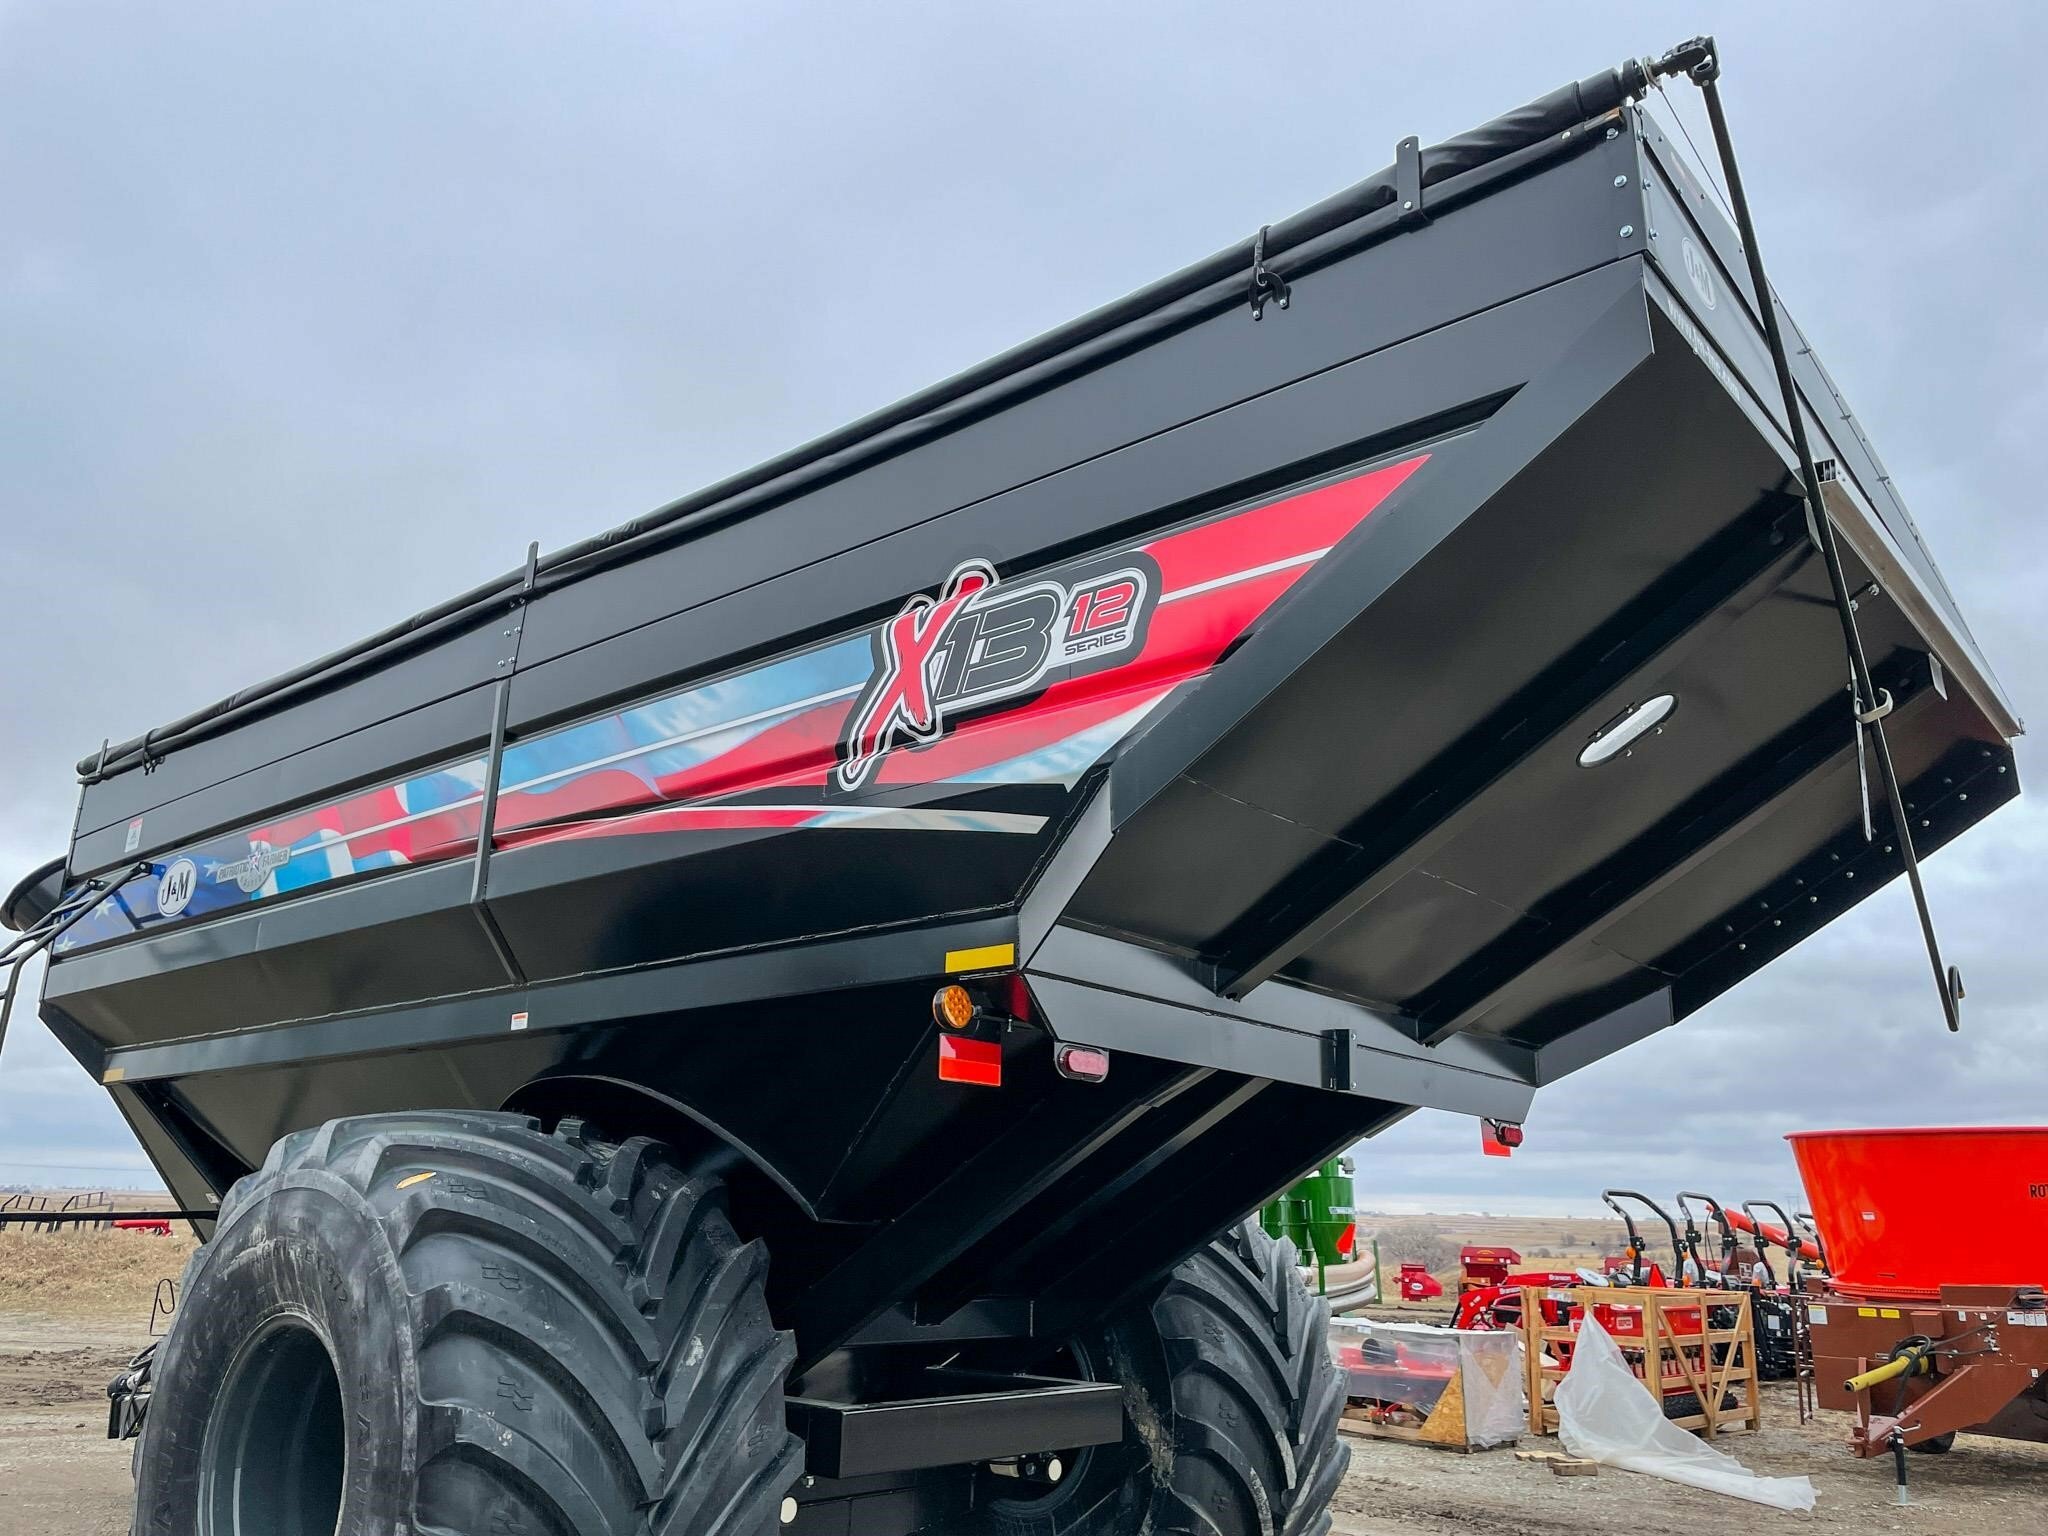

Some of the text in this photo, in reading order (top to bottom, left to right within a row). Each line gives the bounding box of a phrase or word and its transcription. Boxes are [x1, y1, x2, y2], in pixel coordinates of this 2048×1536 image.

[1069, 582, 1135, 636] 12
[1064, 629, 1128, 657] SERIES
[161, 867, 192, 906] J&M
